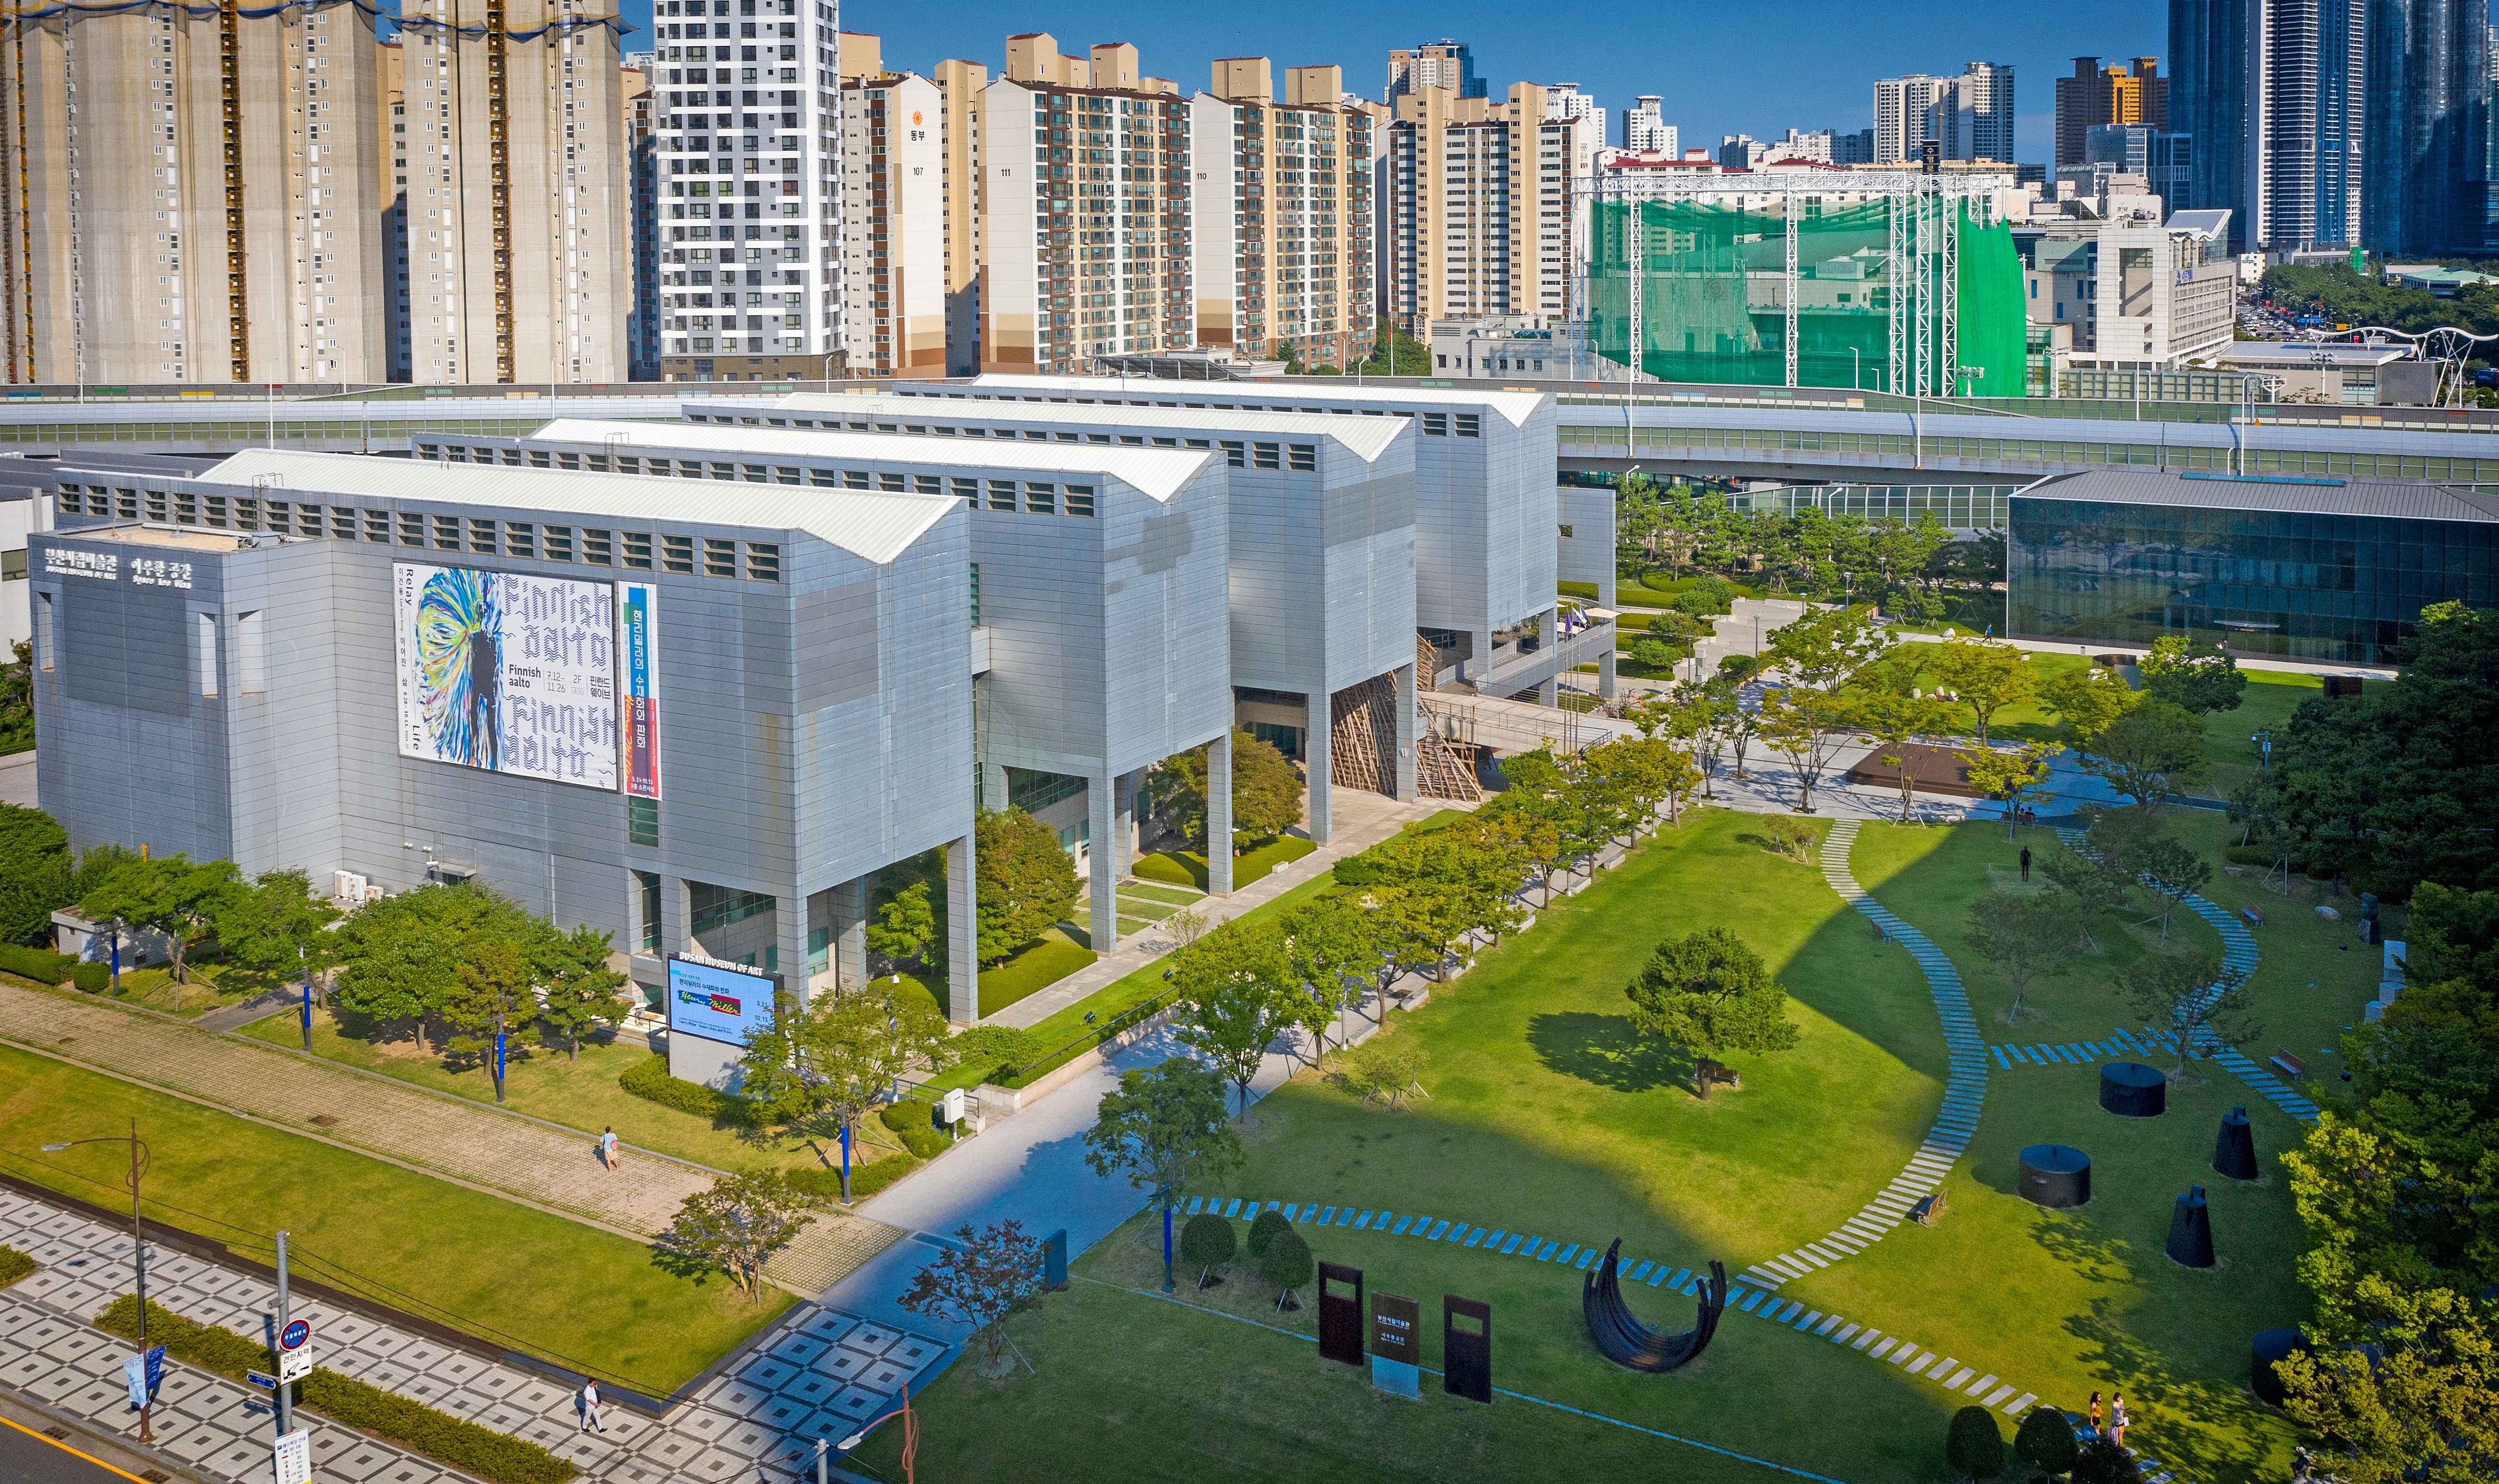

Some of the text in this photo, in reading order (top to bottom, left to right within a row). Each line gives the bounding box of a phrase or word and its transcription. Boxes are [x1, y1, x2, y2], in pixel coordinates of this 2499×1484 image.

[911, 130, 925, 141] 동부
[914, 167, 923, 176] 107
[1001, 168, 1010, 177] 111
[45, 548, 117, 572] 부산시립미술관
[131, 558, 192, 581] 이우환 공간
[405, 569, 421, 750] Relay Life
[509, 664, 541, 678] Finnish
[509, 677, 531, 688] aalto
[573, 675, 582, 684] 2F
[590, 676, 610, 688] 핀란드
[633, 610, 645, 748] 헨리밀러의 수채화와 판화
[547, 682, 566, 693] 11.26
[590, 687, 611, 700] 웨이브
[679, 952, 763, 976] BUSAN MUSEUM OF ART
[681, 990, 741, 1015] Henry Miller
[284, 1348, 309, 1364] 견인지역
